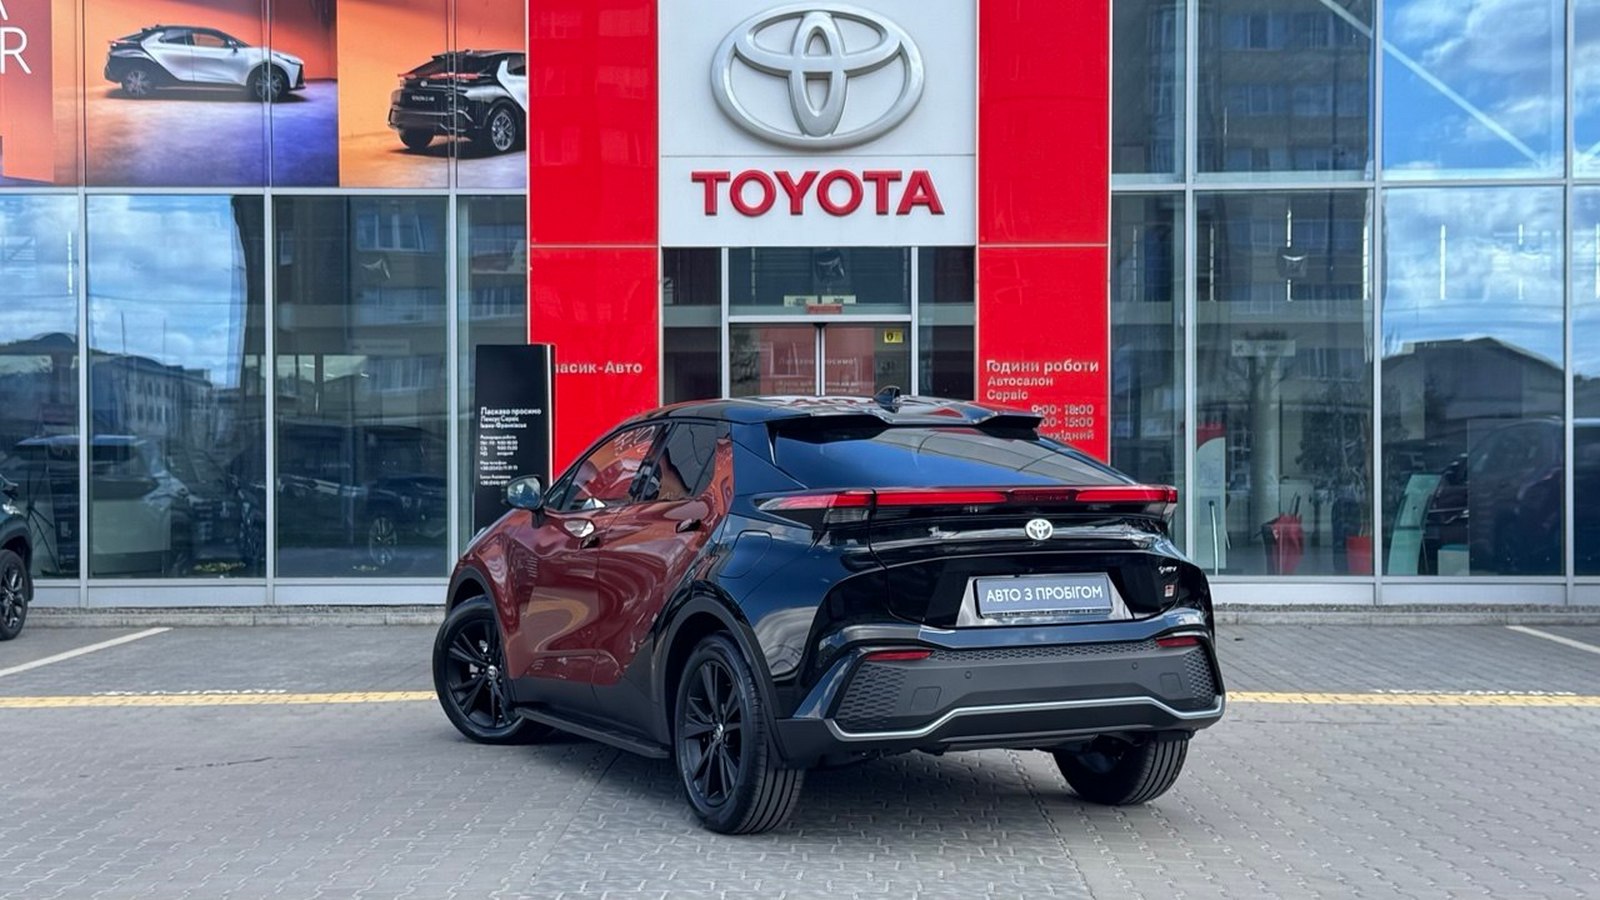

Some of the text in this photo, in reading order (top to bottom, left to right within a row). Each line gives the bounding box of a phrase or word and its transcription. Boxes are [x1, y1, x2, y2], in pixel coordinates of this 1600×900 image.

[691, 169, 945, 217] TOYOTA
[555, 360, 643, 374] асик-Авто
[986, 359, 1099, 375] Години роботи
[987, 376, 1053, 386] Автосалон
[987, 390, 1028, 402] Сервіс
[1065, 404, 1094, 415] 18:00
[1065, 416, 1094, 428] 15:00
[986, 585, 1103, 602] АВТО З ПРОБІГОМ
